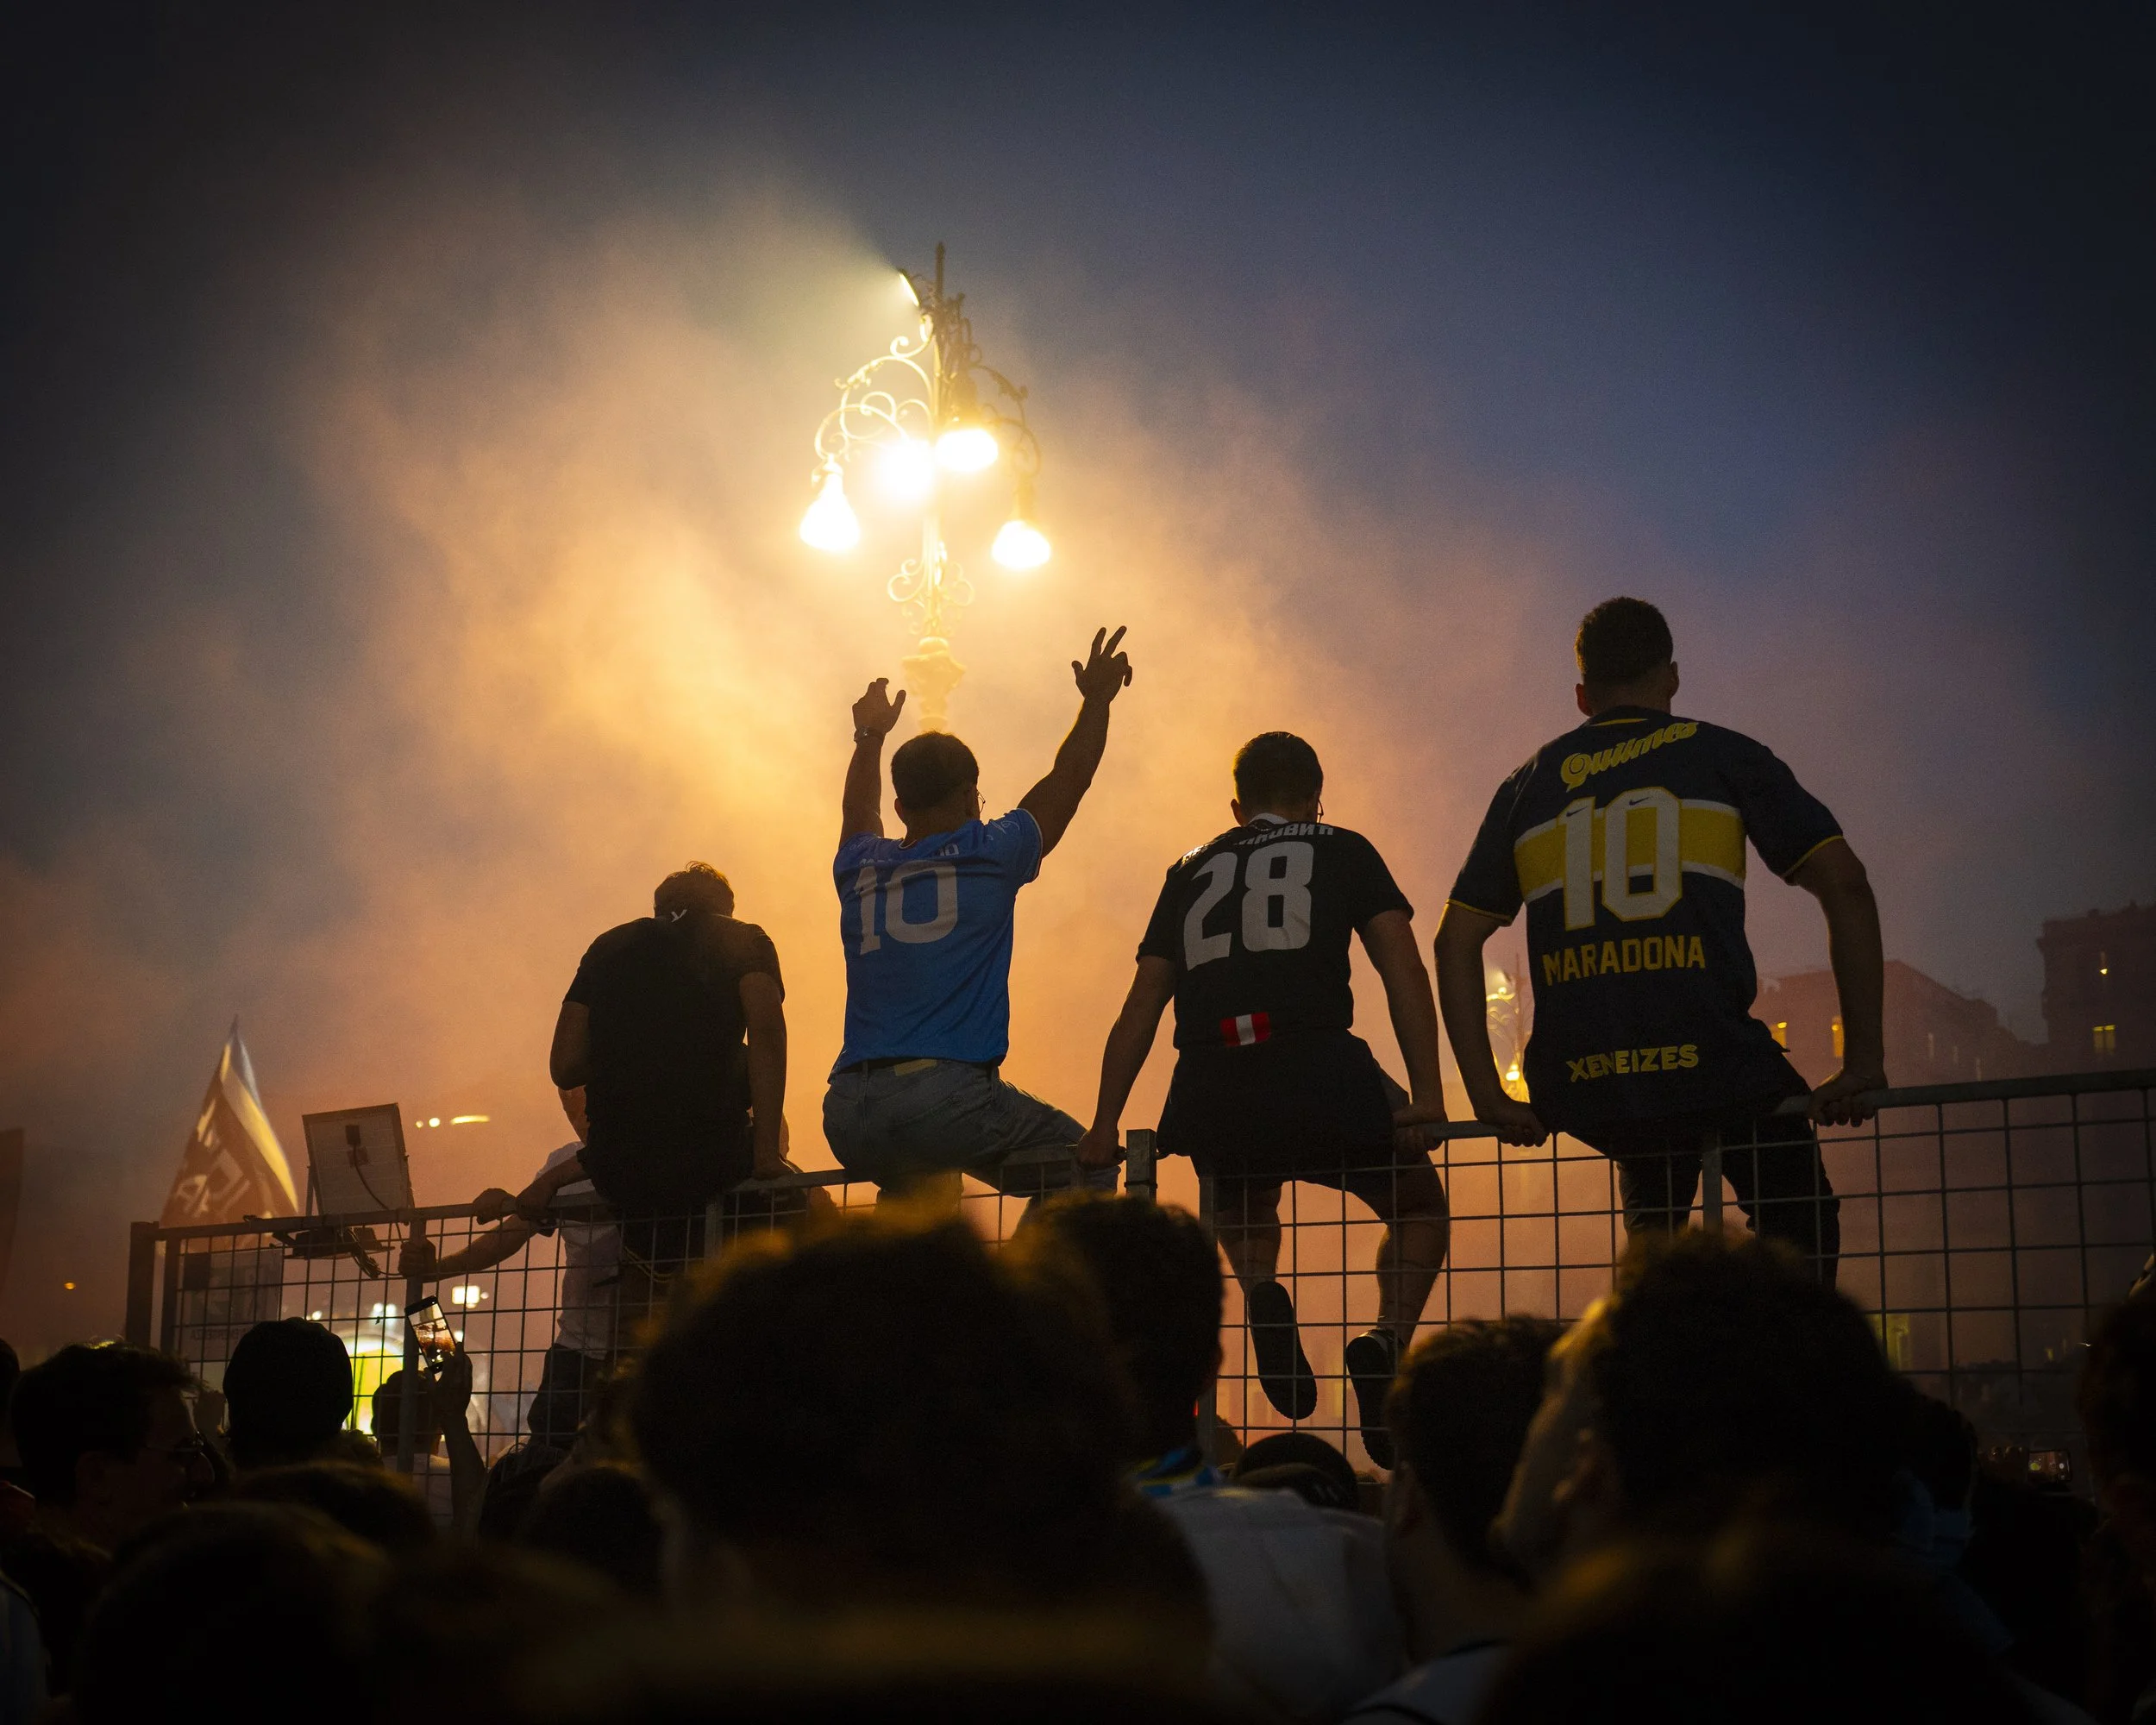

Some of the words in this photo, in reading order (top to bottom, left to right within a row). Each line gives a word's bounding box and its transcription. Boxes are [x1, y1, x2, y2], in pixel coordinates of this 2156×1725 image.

[853, 859, 959, 956] 10
[1183, 841, 1314, 972] 28
[1556, 786, 1683, 932] 10
[1541, 933, 1707, 986] MARADONA
[1566, 1044, 1699, 1083] XENEIZES
